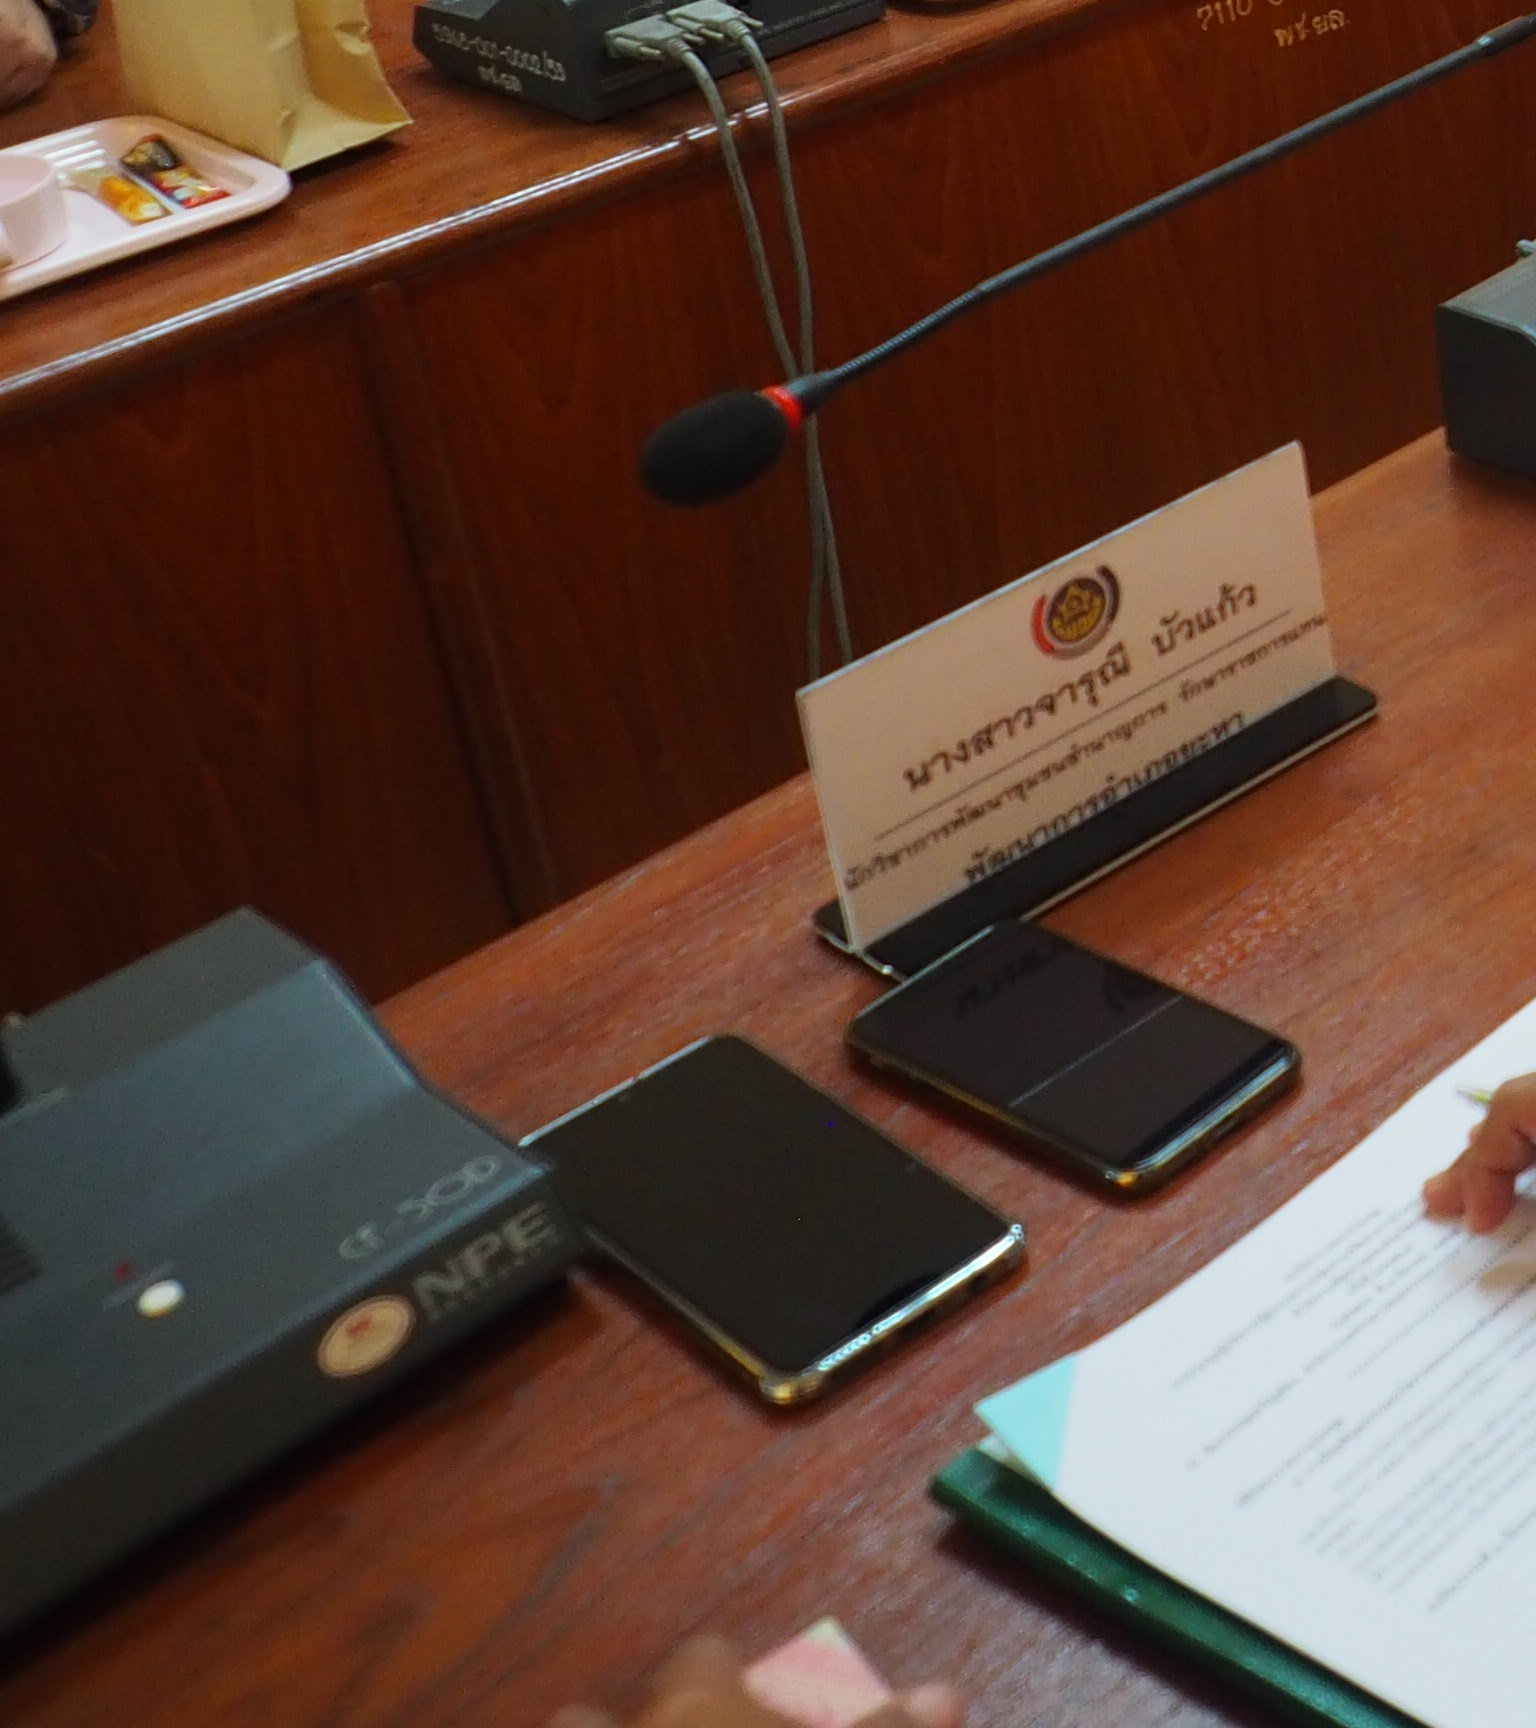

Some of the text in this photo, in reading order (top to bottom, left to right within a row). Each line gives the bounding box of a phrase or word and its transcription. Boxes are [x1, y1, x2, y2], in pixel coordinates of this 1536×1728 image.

[902, 581, 1258, 792] นางสาวจารุณี บัวแก้ว
[412, 1201, 550, 1317] NPE
